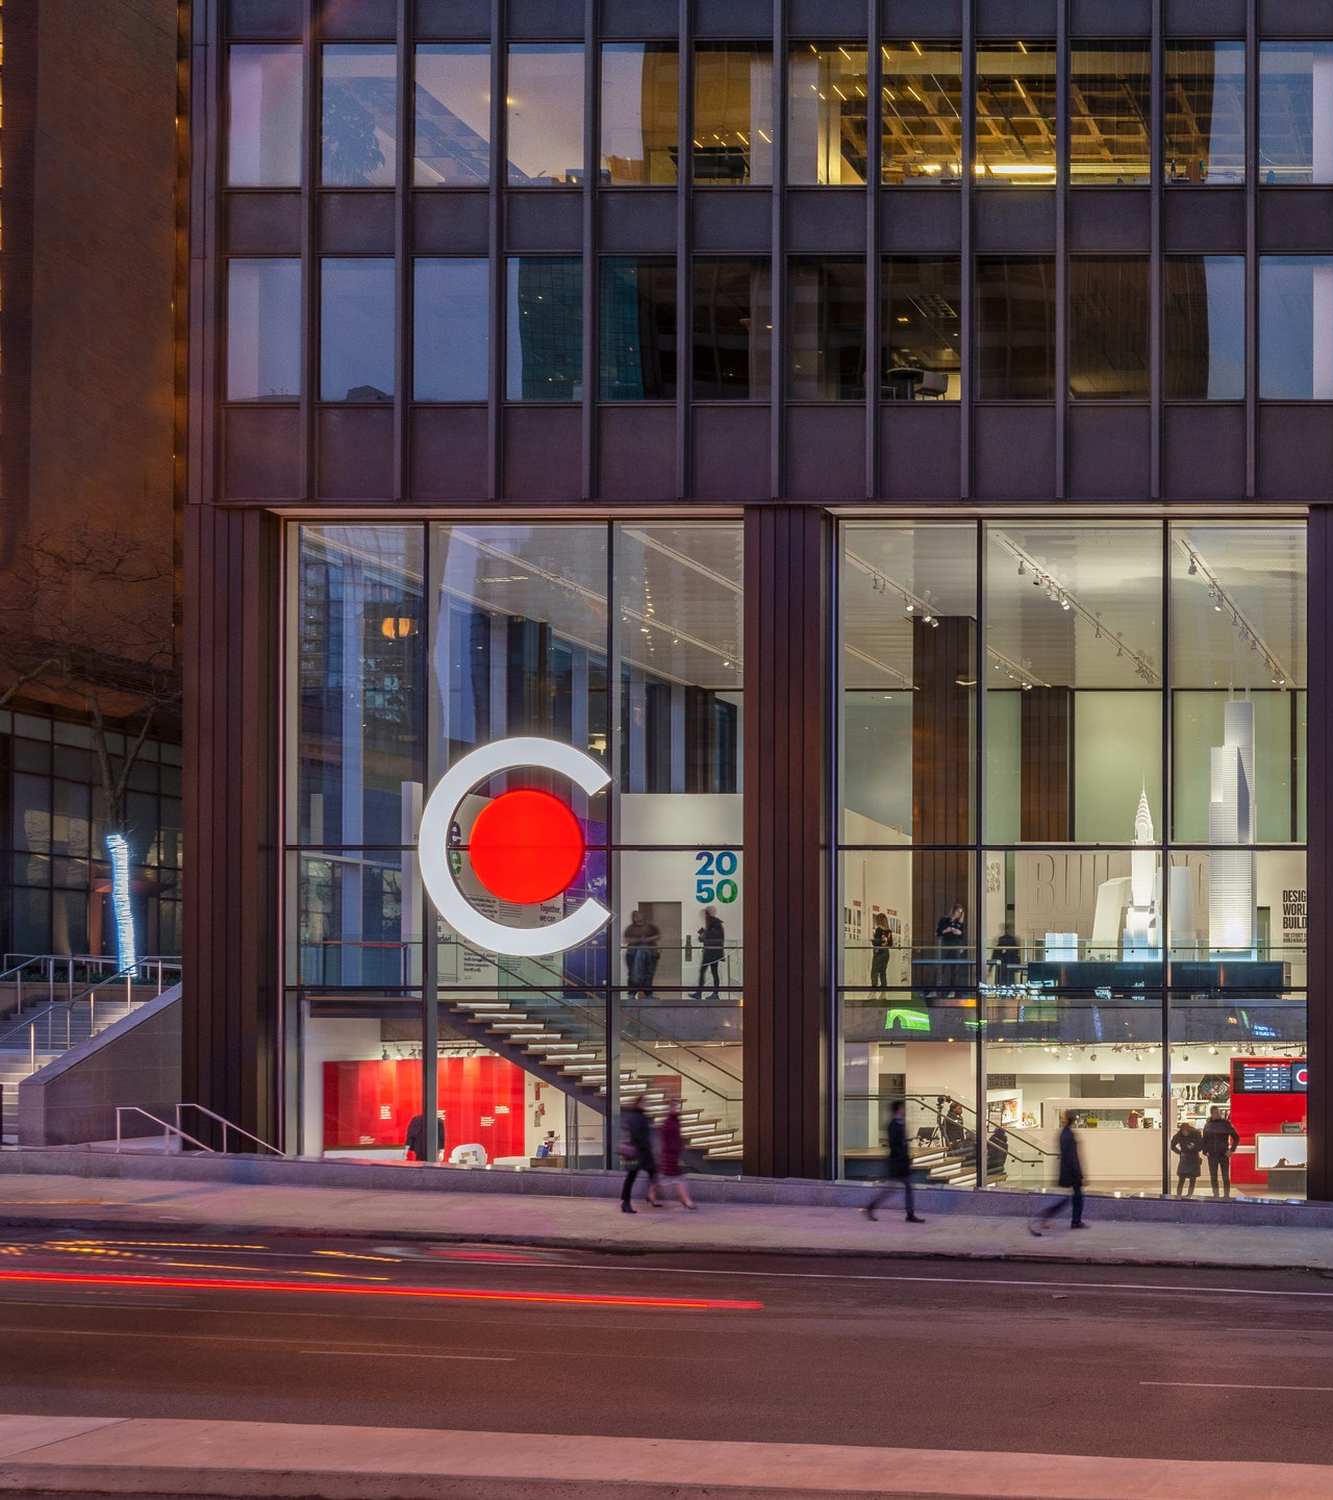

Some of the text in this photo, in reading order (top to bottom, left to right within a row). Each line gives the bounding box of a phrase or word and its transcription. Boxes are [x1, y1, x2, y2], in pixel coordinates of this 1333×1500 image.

[695, 851, 737, 876] 20
[695, 879, 738, 904] 50
[1282, 890, 1307, 902] DESIG
[1282, 903, 1307, 915] WORL
